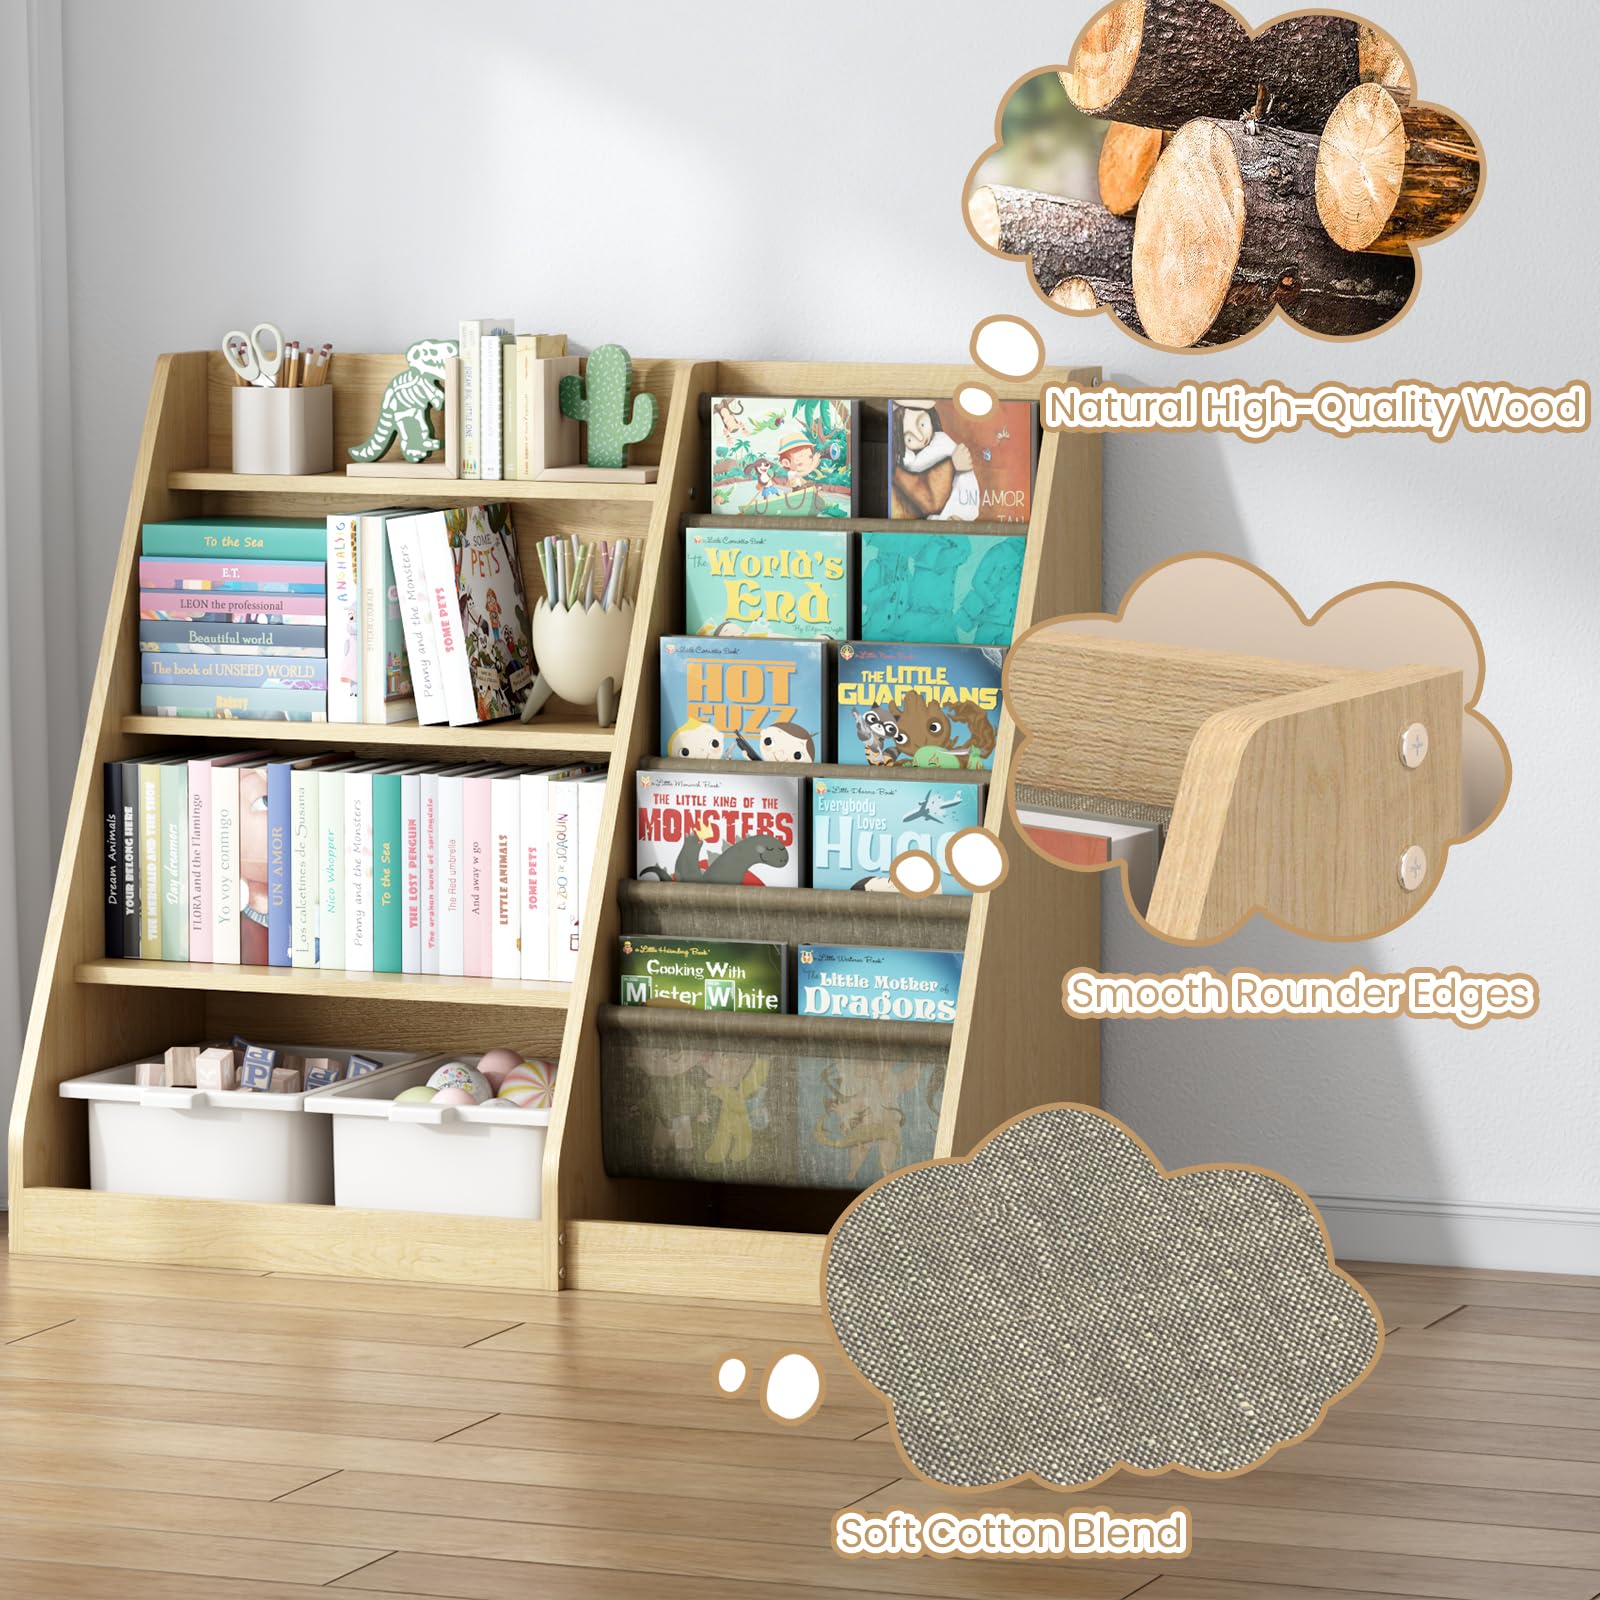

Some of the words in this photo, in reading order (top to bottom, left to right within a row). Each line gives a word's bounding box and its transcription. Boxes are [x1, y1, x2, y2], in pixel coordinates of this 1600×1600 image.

[959, 489, 977, 506] UN
[982, 489, 1024, 507] AMOR
[204, 536, 217, 547] To
[222, 536, 240, 547] the
[244, 537, 264, 548] Sea
[473, 534, 491, 545] SOME
[222, 568, 241, 579] E.T.
[401, 544, 416, 600] Monsters
[471, 547, 500, 578] PETS
[688, 554, 707, 568] The
[704, 547, 845, 580] World's
[180, 599, 209, 609] LEON
[211, 599, 226, 610] the
[228, 600, 284, 613] professional
[435, 587, 448, 618] PETS
[723, 579, 831, 624] End
[413, 606, 422, 627] the
[189, 631, 240, 644] Beautiful
[243, 632, 273, 645] world
[416, 632, 427, 654] and
[440, 620, 454, 653] SOME
[152, 662, 171, 674] The
[173, 662, 200, 676] book
[202, 664, 214, 676] of
[215, 664, 264, 677] UNSEED
[266, 665, 315, 678] WORLD
[421, 659, 433, 697] Penny
[687, 663, 797, 705] HOT
[861, 670, 885, 683] THE
[886, 665, 949, 685] LITTLE
[687, 704, 797, 733] FUZZ
[295, 787, 308, 838] Susana
[653, 793, 670, 805] THE
[676, 794, 707, 806] LITTLE
[713, 796, 736, 808] KING
[743, 797, 755, 809] OF
[762, 798, 779, 809] THE
[818, 796, 876, 815] Everybody
[124, 806, 133, 834] HERE
[191, 793, 203, 847] Flamingo
[353, 799, 362, 853] Monsters
[638, 807, 794, 847] MONSTERS
[857, 814, 887, 831] Loves
[108, 813, 117, 861] Animals
[220, 808, 232, 870] conmigo
[295, 841, 306, 857] de
[408, 818, 417, 869] PENGUIN
[472, 841, 482, 854] go
[125, 837, 134, 882] BELONG
[192, 849, 201, 870] the
[271, 826, 283, 877] AMOR
[327, 829, 338, 881] Whopper
[353, 855, 362, 876] the
[381, 841, 391, 863] Sea
[498, 834, 508, 884] ANIMALS
[528, 847, 538, 876] PETS
[108, 864, 117, 905] Dream
[192, 871, 201, 894] and
[221, 875, 232, 900] voy
[296, 859, 309, 924] calcetines
[381, 867, 392, 888] the
[408, 872, 418, 902] LOST
[448, 877, 457, 896] Red
[472, 865, 482, 893] away
[125, 883, 135, 916] YOUR
[166, 879, 181, 905] Day
[271, 884, 283, 906] UN
[327, 886, 336, 914] Nico
[353, 882, 362, 905] and
[381, 892, 392, 907] To
[448, 896, 457, 912] The
[472, 893, 480, 916] And
[499, 886, 509, 926] LITTLE
[528, 879, 538, 911] SOME
[192, 895, 202, 931] FLORA
[219, 905, 231, 924] Yo
[408, 905, 418, 929] THE
[296, 926, 309, 953] Los
[353, 908, 365, 947] Penny
[646, 959, 704, 980] Cooking
[705, 961, 746, 979] With
[820, 972, 869, 989] Little
[874, 975, 938, 993] Mother
[626, 982, 702, 1006] Mister
[707, 985, 779, 1010] White
[804, 986, 957, 1021] Dragons
